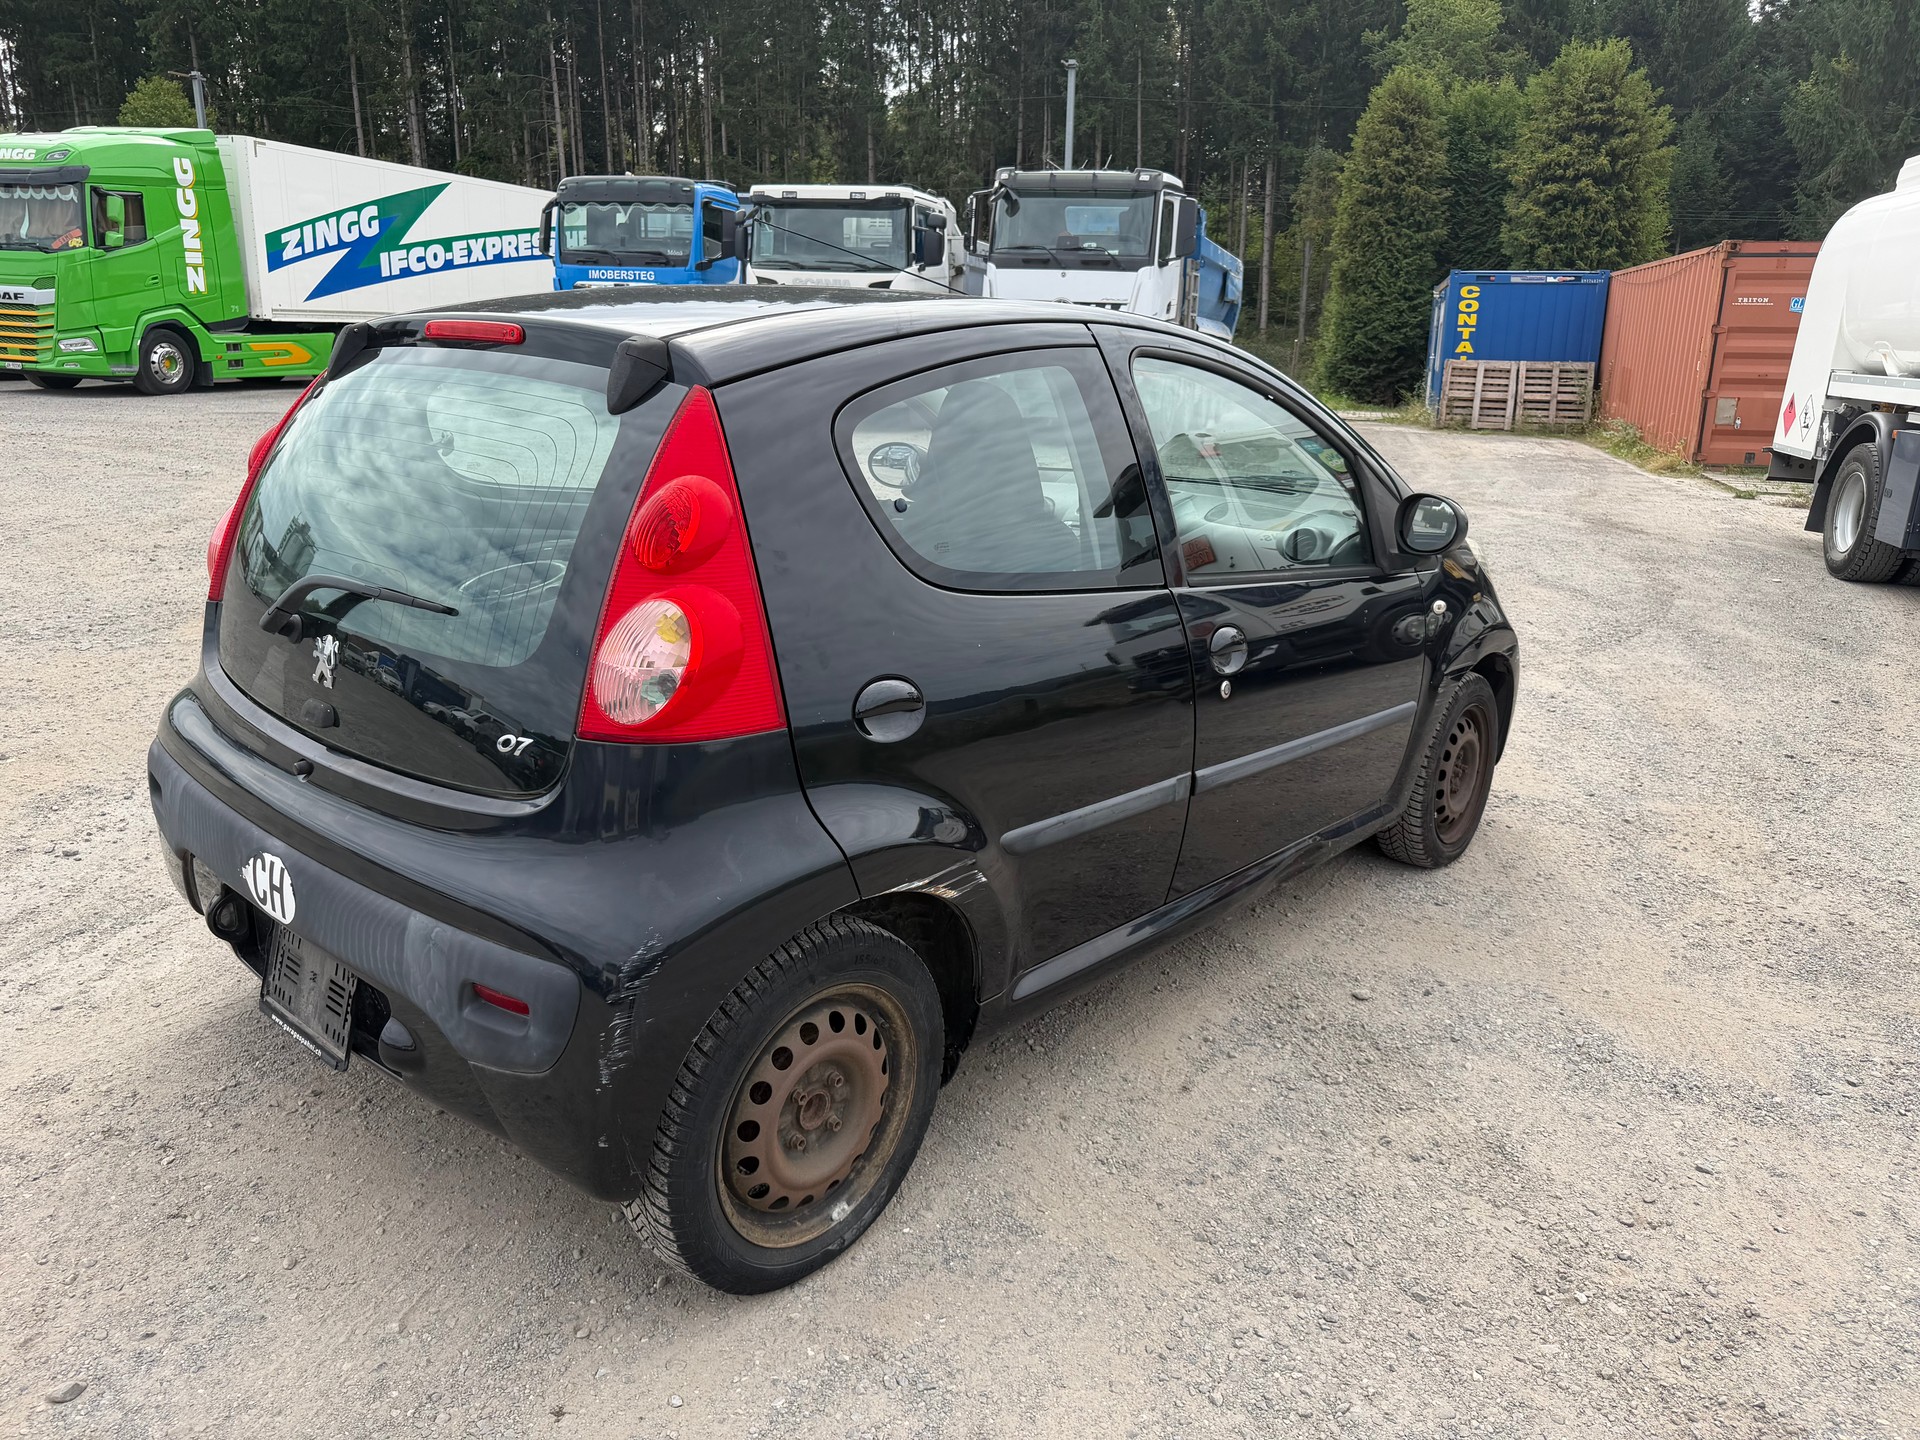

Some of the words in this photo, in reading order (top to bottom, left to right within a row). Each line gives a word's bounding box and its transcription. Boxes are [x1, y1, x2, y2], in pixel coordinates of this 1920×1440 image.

[173, 157, 207, 294] ZINGG
[281, 205, 380, 261] ZINGG
[588, 269, 655, 281] IMOBERSTEG
[0, 291, 24, 300] AF
[496, 734, 534, 757] 07
[252, 852, 287, 920] CH
